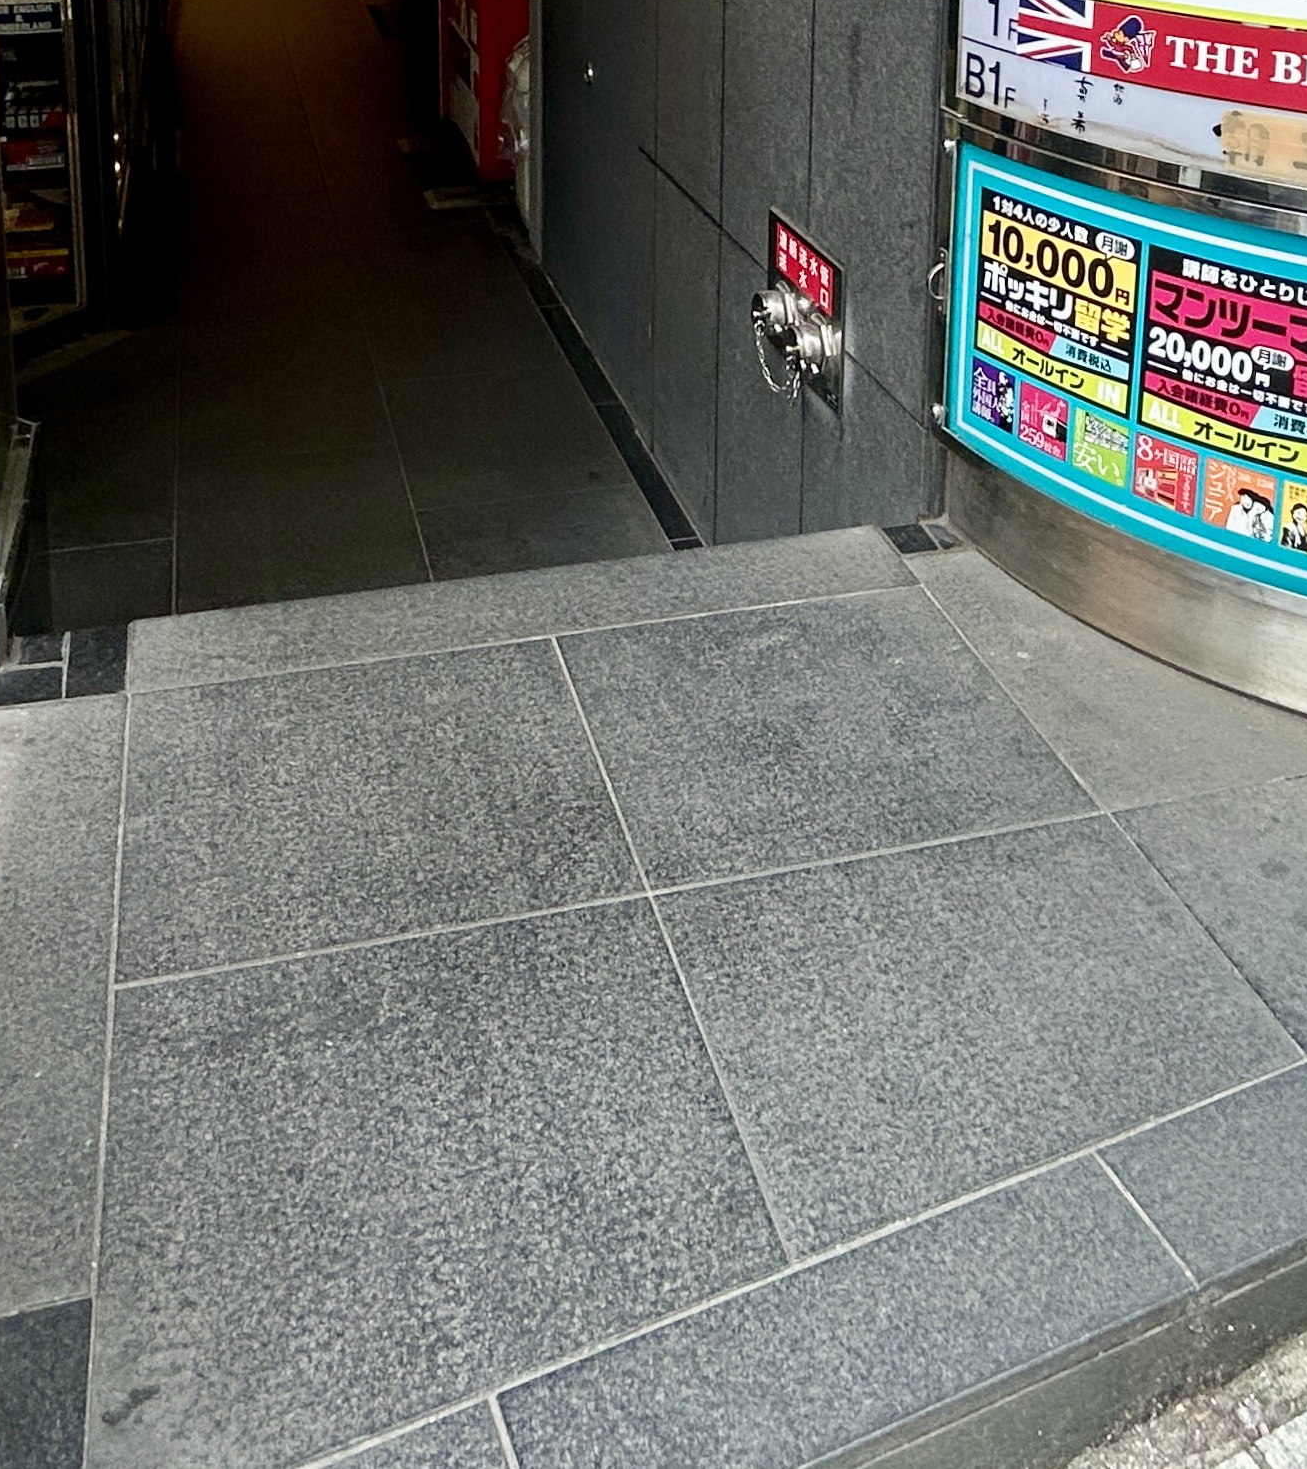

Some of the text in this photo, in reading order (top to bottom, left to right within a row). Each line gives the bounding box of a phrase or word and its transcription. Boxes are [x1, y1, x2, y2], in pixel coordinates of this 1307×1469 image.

[1165, 34, 1260, 79] THE
[964, 51, 1017, 110] B1F
[1101, 235, 1129, 257] 月謝
[980, 328, 1122, 407] ALL オールイン IN
[1065, 344, 1113, 374] 消費税込
[1257, 348, 1288, 369] 月謝
[1147, 400, 1182, 429] ALL
[1193, 419, 1301, 464] オールイン
